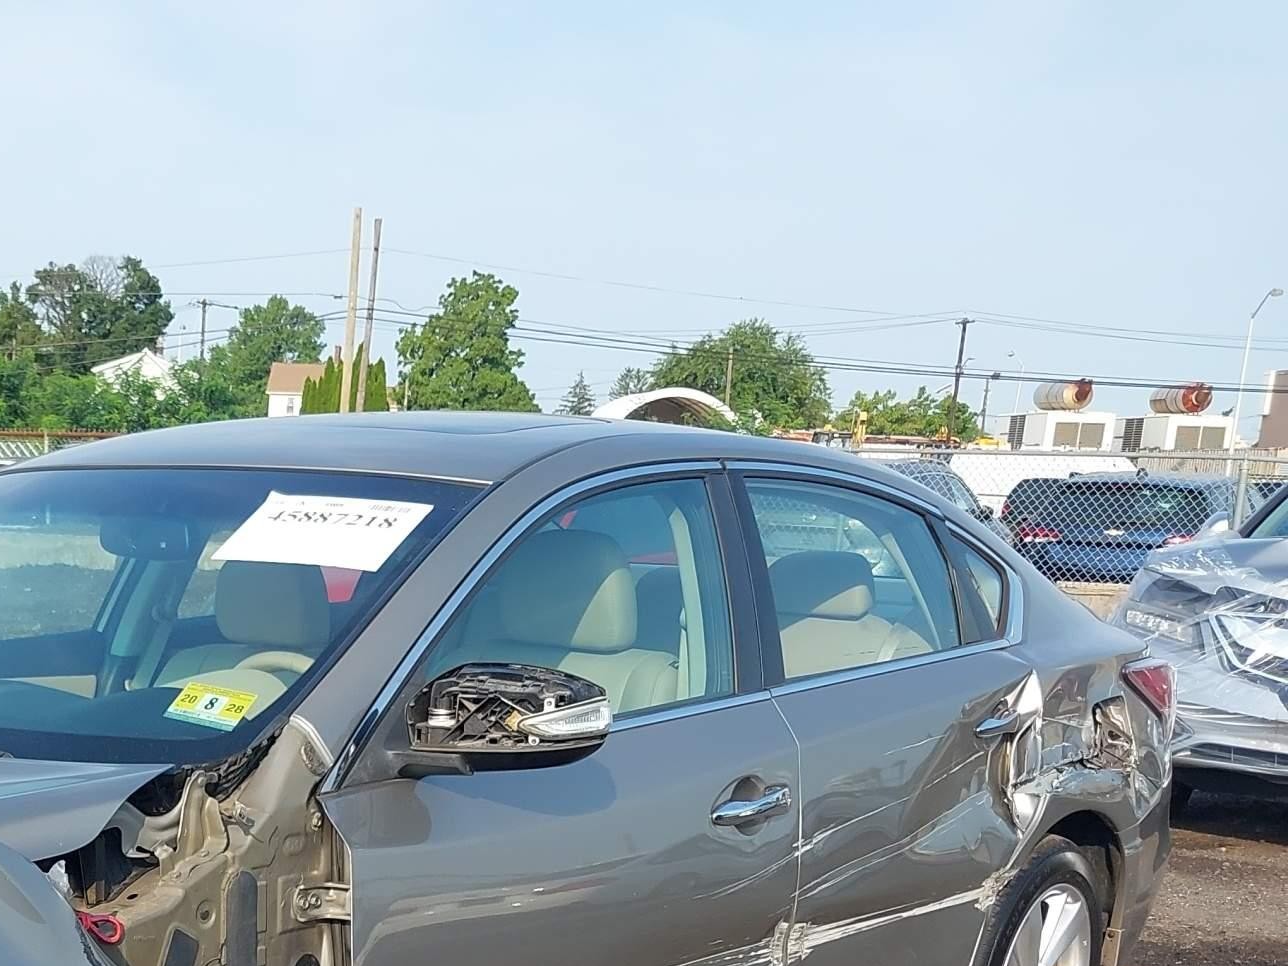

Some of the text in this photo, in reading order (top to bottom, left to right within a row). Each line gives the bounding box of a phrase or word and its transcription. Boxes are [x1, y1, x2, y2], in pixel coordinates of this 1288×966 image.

[267, 509, 398, 529] 45887218
[180, 693, 198, 704] 20
[204, 697, 219, 710] 8
[225, 703, 244, 714] 28
